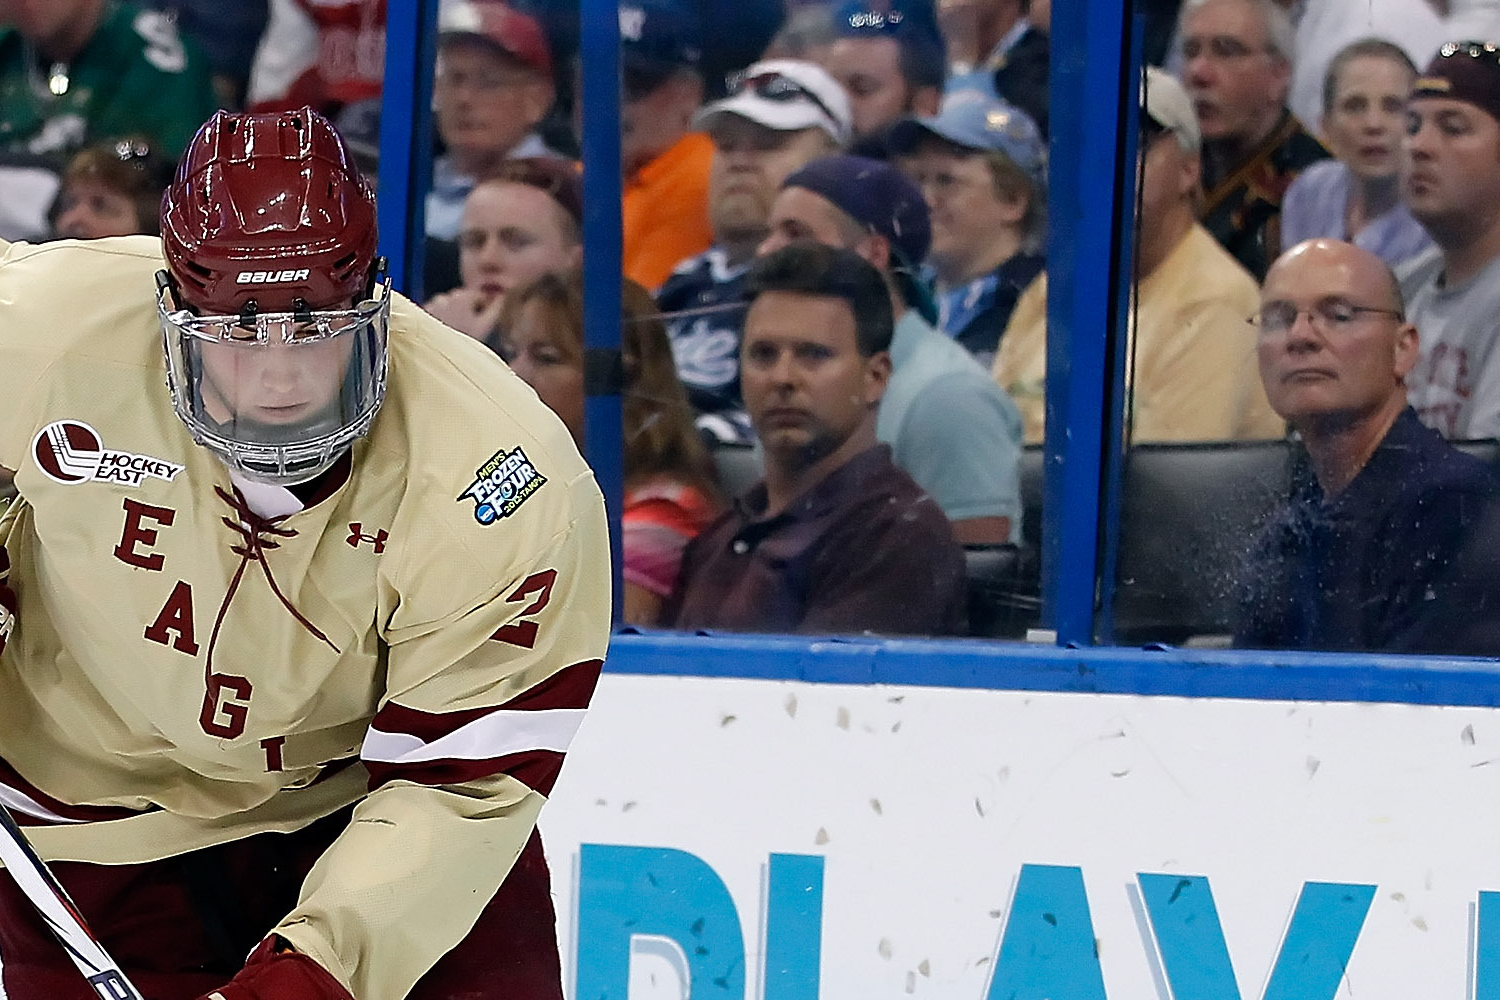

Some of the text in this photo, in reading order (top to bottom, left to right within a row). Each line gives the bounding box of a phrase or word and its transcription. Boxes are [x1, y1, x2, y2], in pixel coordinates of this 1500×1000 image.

[236, 269, 310, 284] BAUER
[95, 466, 145, 484] EAST
[100, 452, 179, 479] HOCKEY
[464, 450, 526, 504] FROZEN
[481, 463, 536, 516] FOUR
[488, 568, 558, 650] 2
